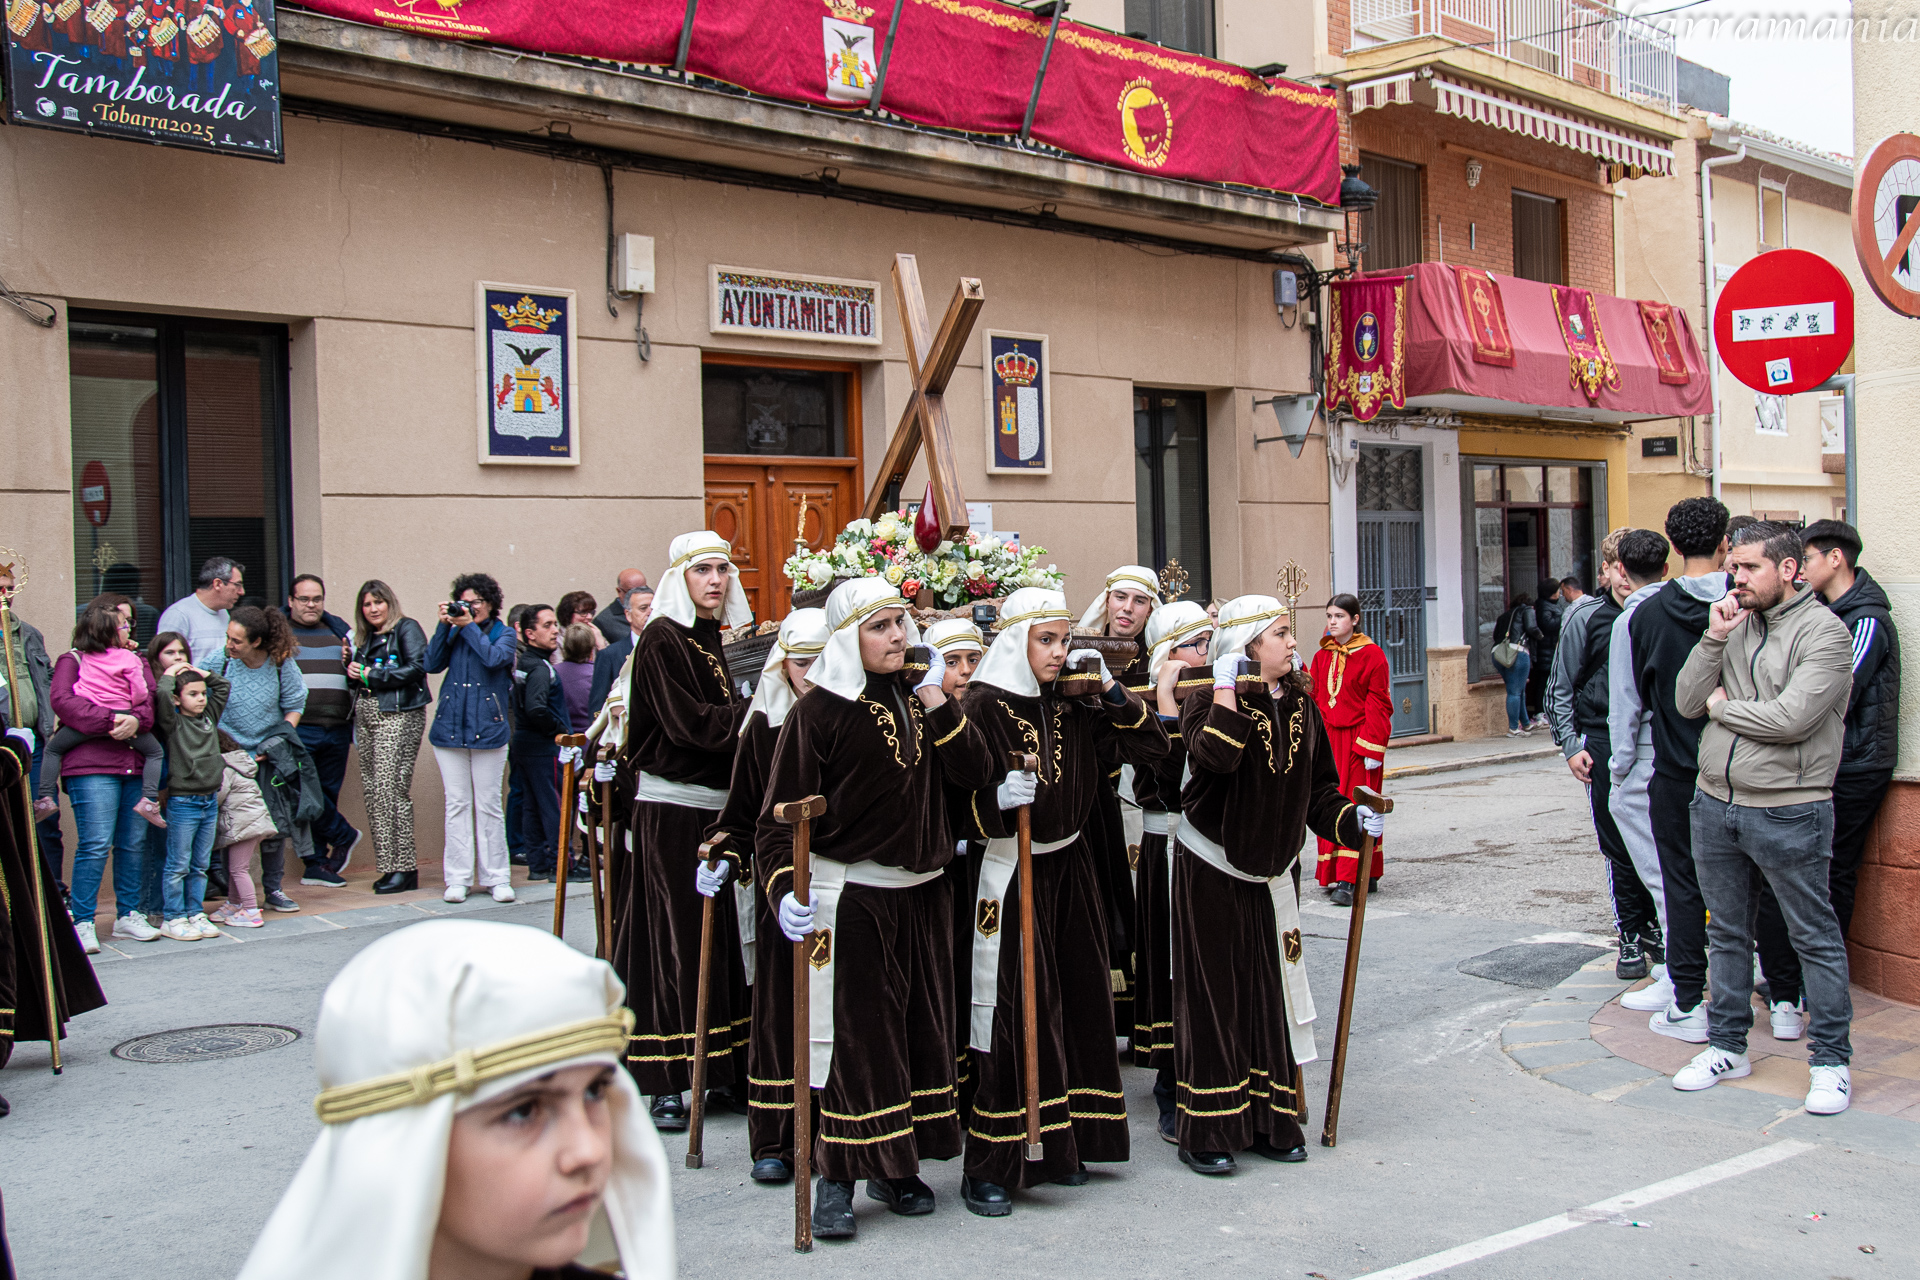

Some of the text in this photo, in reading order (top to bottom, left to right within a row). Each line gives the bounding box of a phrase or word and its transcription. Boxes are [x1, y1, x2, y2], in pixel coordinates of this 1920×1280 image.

[373, 8, 491, 34] SEMANA SANTA TOBARRA
[34, 51, 257, 121] Tamborada
[721, 288, 871, 336] AYUNTAMIENTO
